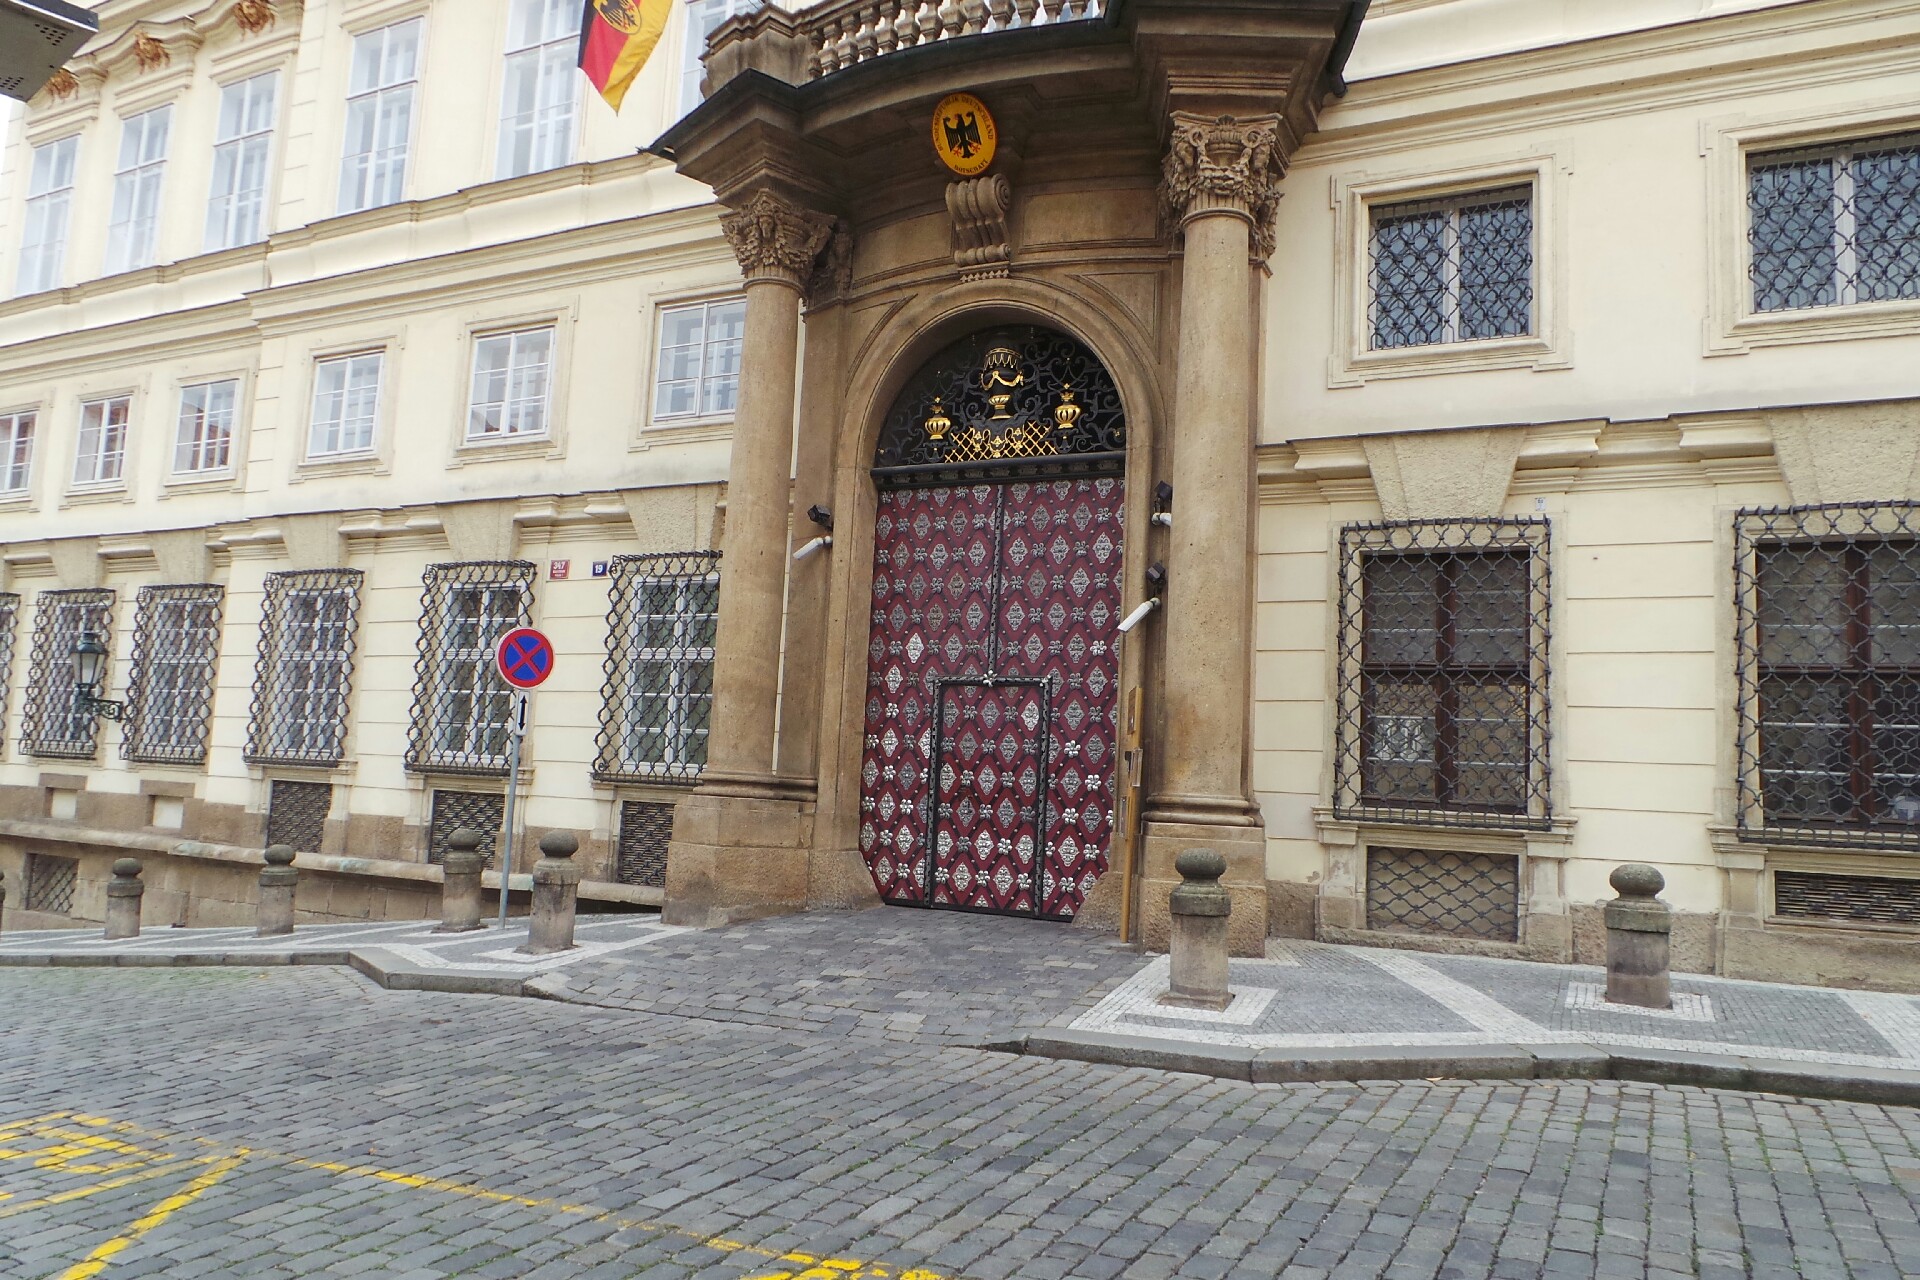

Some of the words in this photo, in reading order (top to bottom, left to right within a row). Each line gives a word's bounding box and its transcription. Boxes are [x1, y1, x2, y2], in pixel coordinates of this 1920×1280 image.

[962, 96, 994, 140] DEUTSCHLAND
[954, 158, 988, 173] BOTSCHAFT
[553, 561, 566, 570] 347
[595, 564, 604, 574] 19
